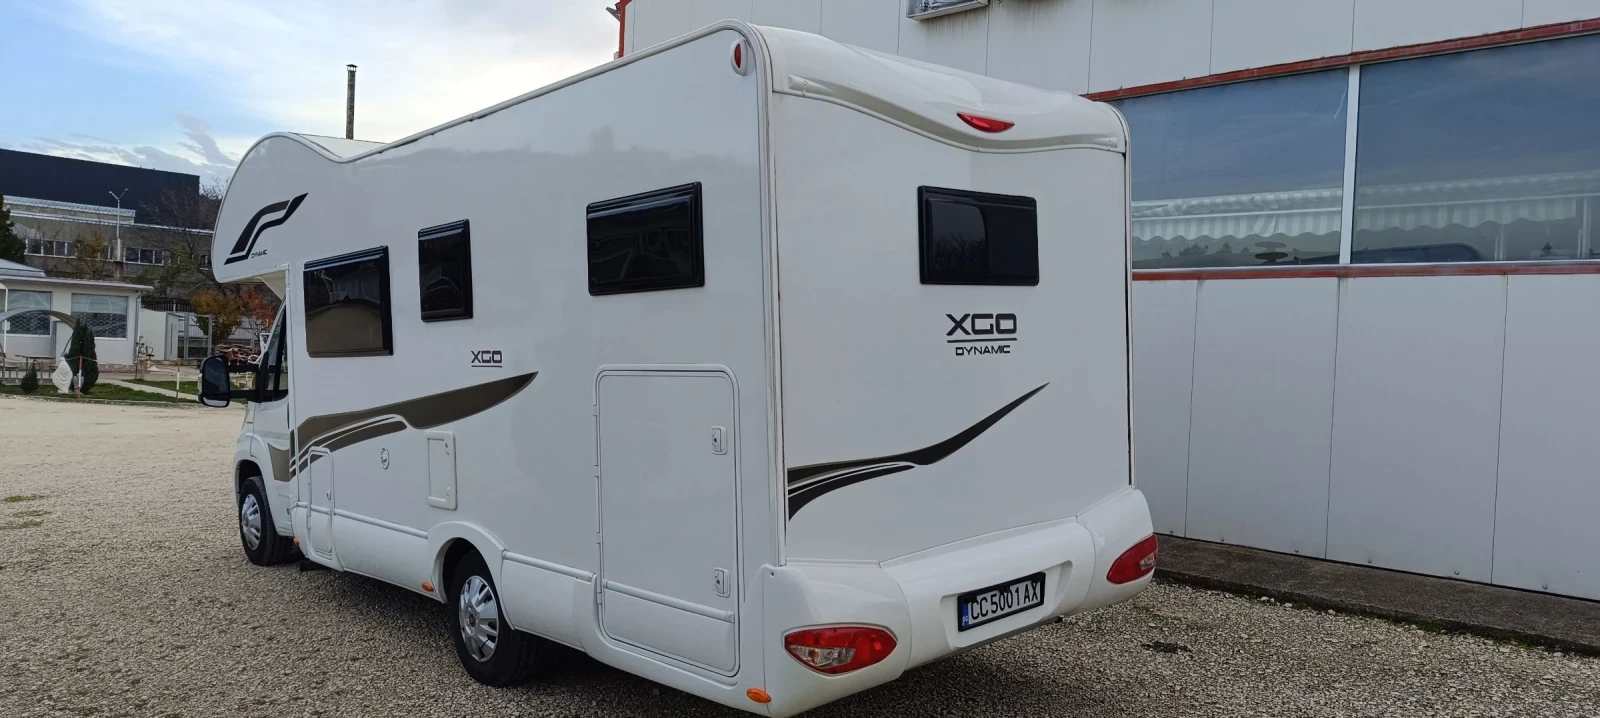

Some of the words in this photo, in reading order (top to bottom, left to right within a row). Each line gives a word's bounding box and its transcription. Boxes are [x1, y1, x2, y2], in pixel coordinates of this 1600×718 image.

[945, 313, 1017, 336] XGO
[470, 350, 502, 364] XGO
[955, 344, 1011, 356] DYNAMIC
